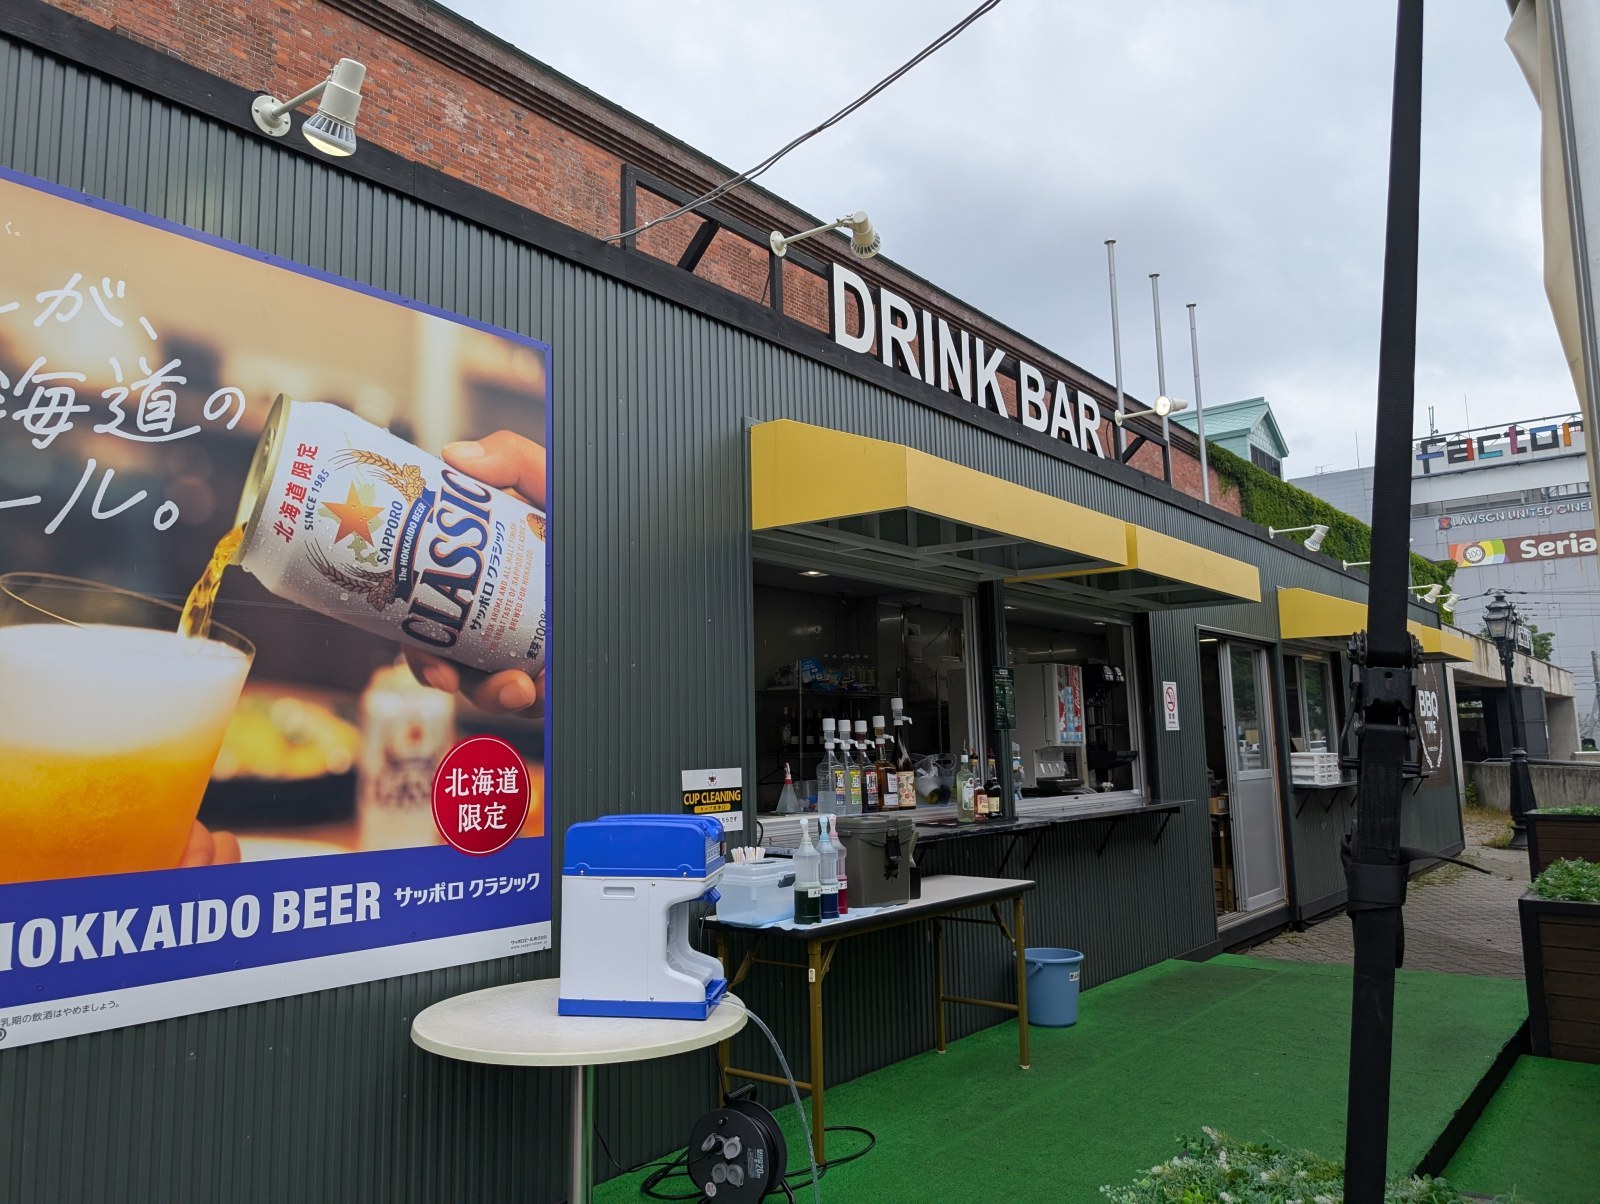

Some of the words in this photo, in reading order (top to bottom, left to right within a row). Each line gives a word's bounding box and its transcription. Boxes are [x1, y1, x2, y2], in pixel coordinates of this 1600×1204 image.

[833, 262, 1009, 419] DRINK
[1020, 361, 1105, 460] BAR
[273, 482, 307, 543] 北海道
[291, 443, 318, 480] 限定
[305, 496, 317, 531] SINCE
[312, 468, 330, 493] 1985
[411, 502, 426, 522] BEER
[1452, 512, 1505, 527] LAWSON
[1507, 507, 1553, 520] UNITED
[1557, 501, 1592, 514] CINE
[376, 500, 403, 565] SAPPORO
[400, 522, 418, 566] HOKKAIDO
[1467, 549, 1482, 559] 100
[1519, 533, 1598, 559] Seria
[399, 566, 407, 581] The
[401, 469, 493, 649] CLASSIC
[503, 565, 512, 579] ALL
[512, 554, 523, 586] SAPPORO
[470, 582, 495, 630] サッポロ
[487, 520, 506, 579] クラシック
[499, 580, 508, 597] AND
[509, 587, 517, 598] OF
[491, 597, 504, 622] AROMA
[502, 599, 514, 619] TASTE
[509, 603, 523, 631] BREWED
[518, 586, 527, 601] FOR
[1418, 690, 1439, 720] BBQ
[445, 766, 519, 797] 北海道
[683, 793, 700, 805] CUP
[701, 790, 741, 804] CLEANING
[458, 802, 507, 833] 限定
[394, 881, 464, 908] サッポロ
[469, 872, 540, 898] クラシック
[271, 881, 381, 934] BEER
